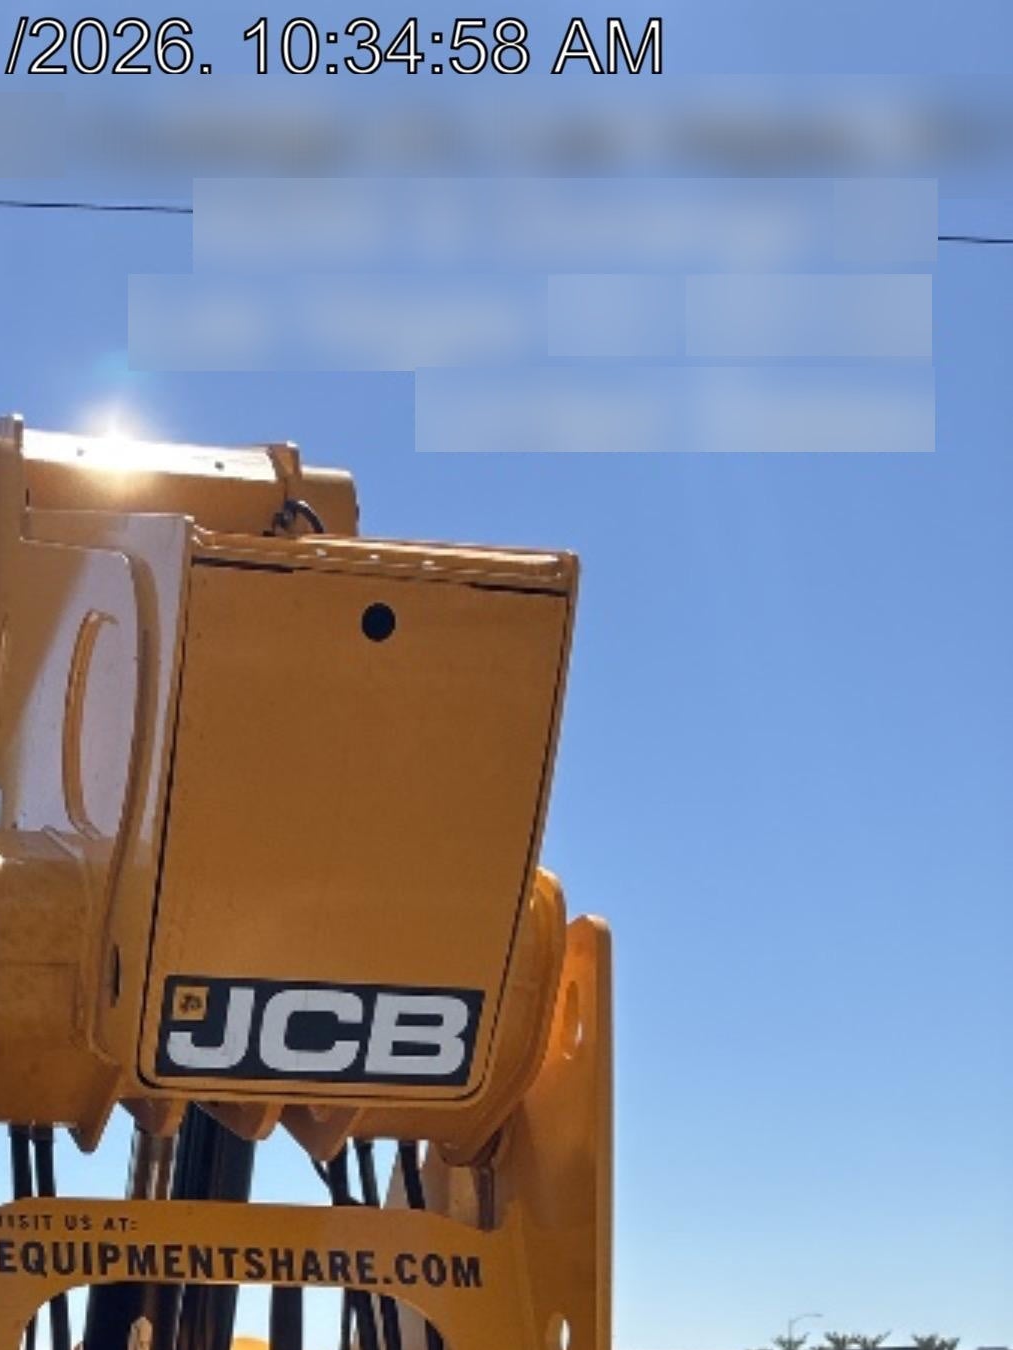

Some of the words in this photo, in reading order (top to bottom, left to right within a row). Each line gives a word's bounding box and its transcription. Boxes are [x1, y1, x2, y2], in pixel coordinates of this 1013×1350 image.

[166, 986, 469, 1075] JCB
[64, 1214, 92, 1231] US
[103, 1217, 137, 1232] AT:
